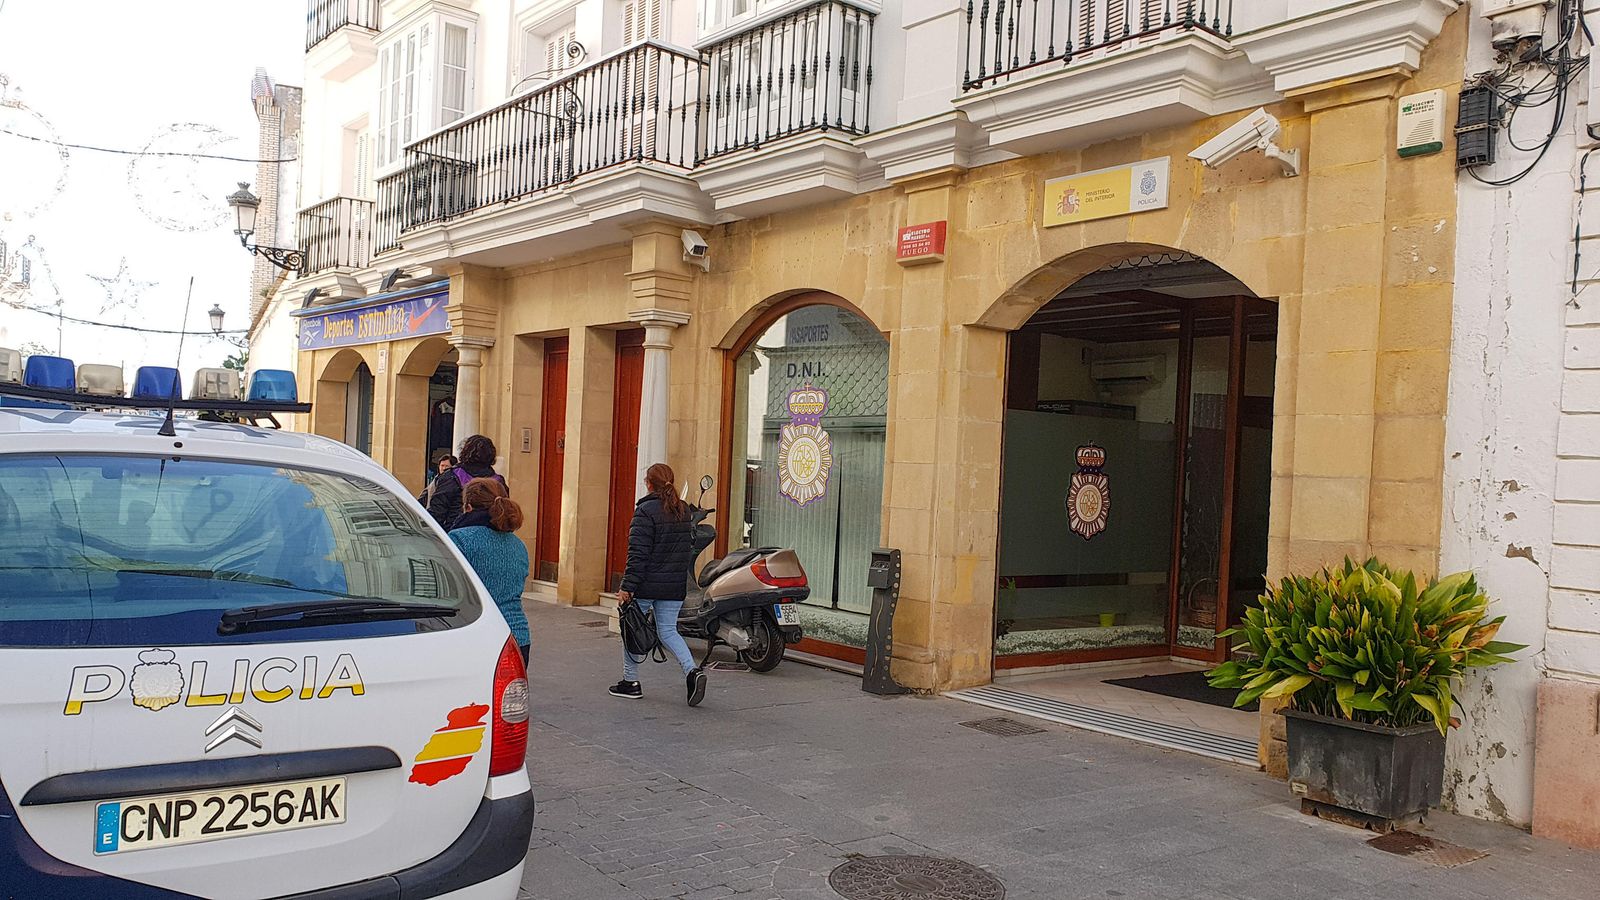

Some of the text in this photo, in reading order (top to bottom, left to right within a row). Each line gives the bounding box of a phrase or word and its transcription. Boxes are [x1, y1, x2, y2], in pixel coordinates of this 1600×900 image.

[1085, 188, 1110, 197] MINISTERIO
[1094, 193, 1115, 202] INTERIOR
[902, 246, 928, 256] FUEGO
[323, 305, 404, 344] Deportes ESTUDILLO
[789, 324, 829, 344] PASAPORTES
[787, 361, 826, 379] D.N.I.
[103, 833, 113, 845] E
